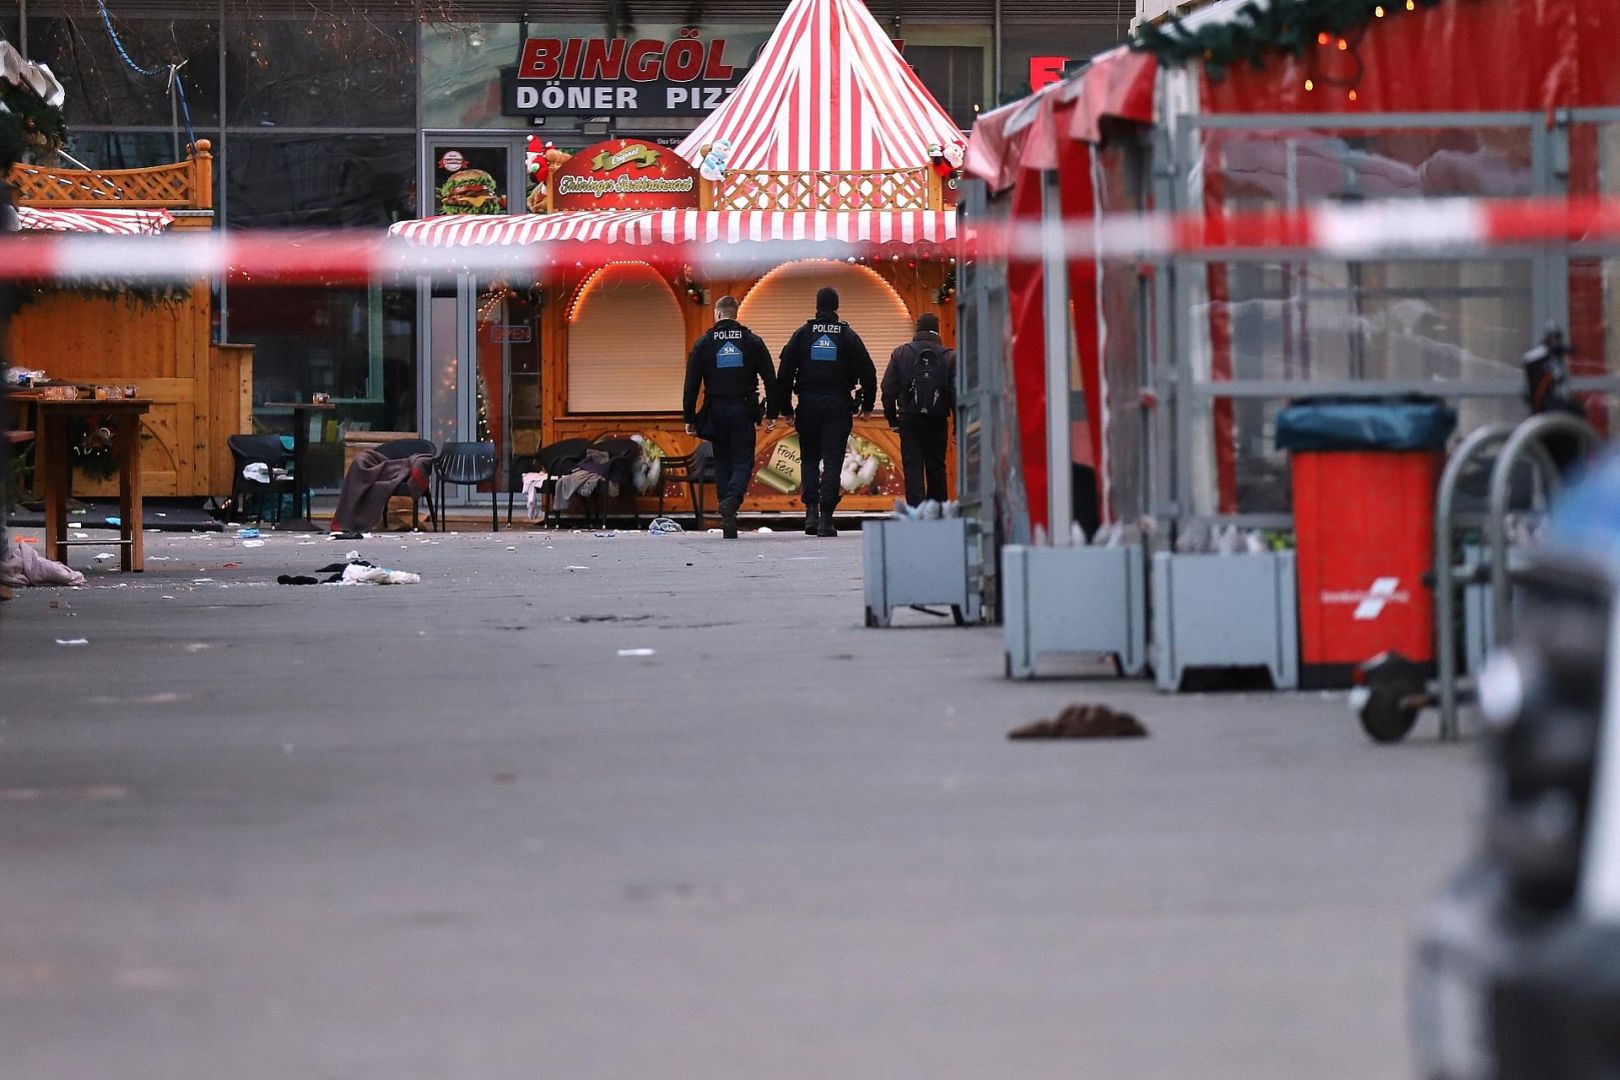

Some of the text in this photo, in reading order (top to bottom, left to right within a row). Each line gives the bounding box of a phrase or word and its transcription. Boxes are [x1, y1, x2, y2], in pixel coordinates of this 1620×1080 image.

[518, 28, 734, 82] BINGÖL
[517, 81, 638, 109] DÖNER
[713, 330, 742, 340] POLIZEI
[813, 324, 841, 333] POLIZEI
[724, 346, 735, 354] SN
[777, 444, 801, 463] Frohe
[775, 459, 795, 477] Fest
